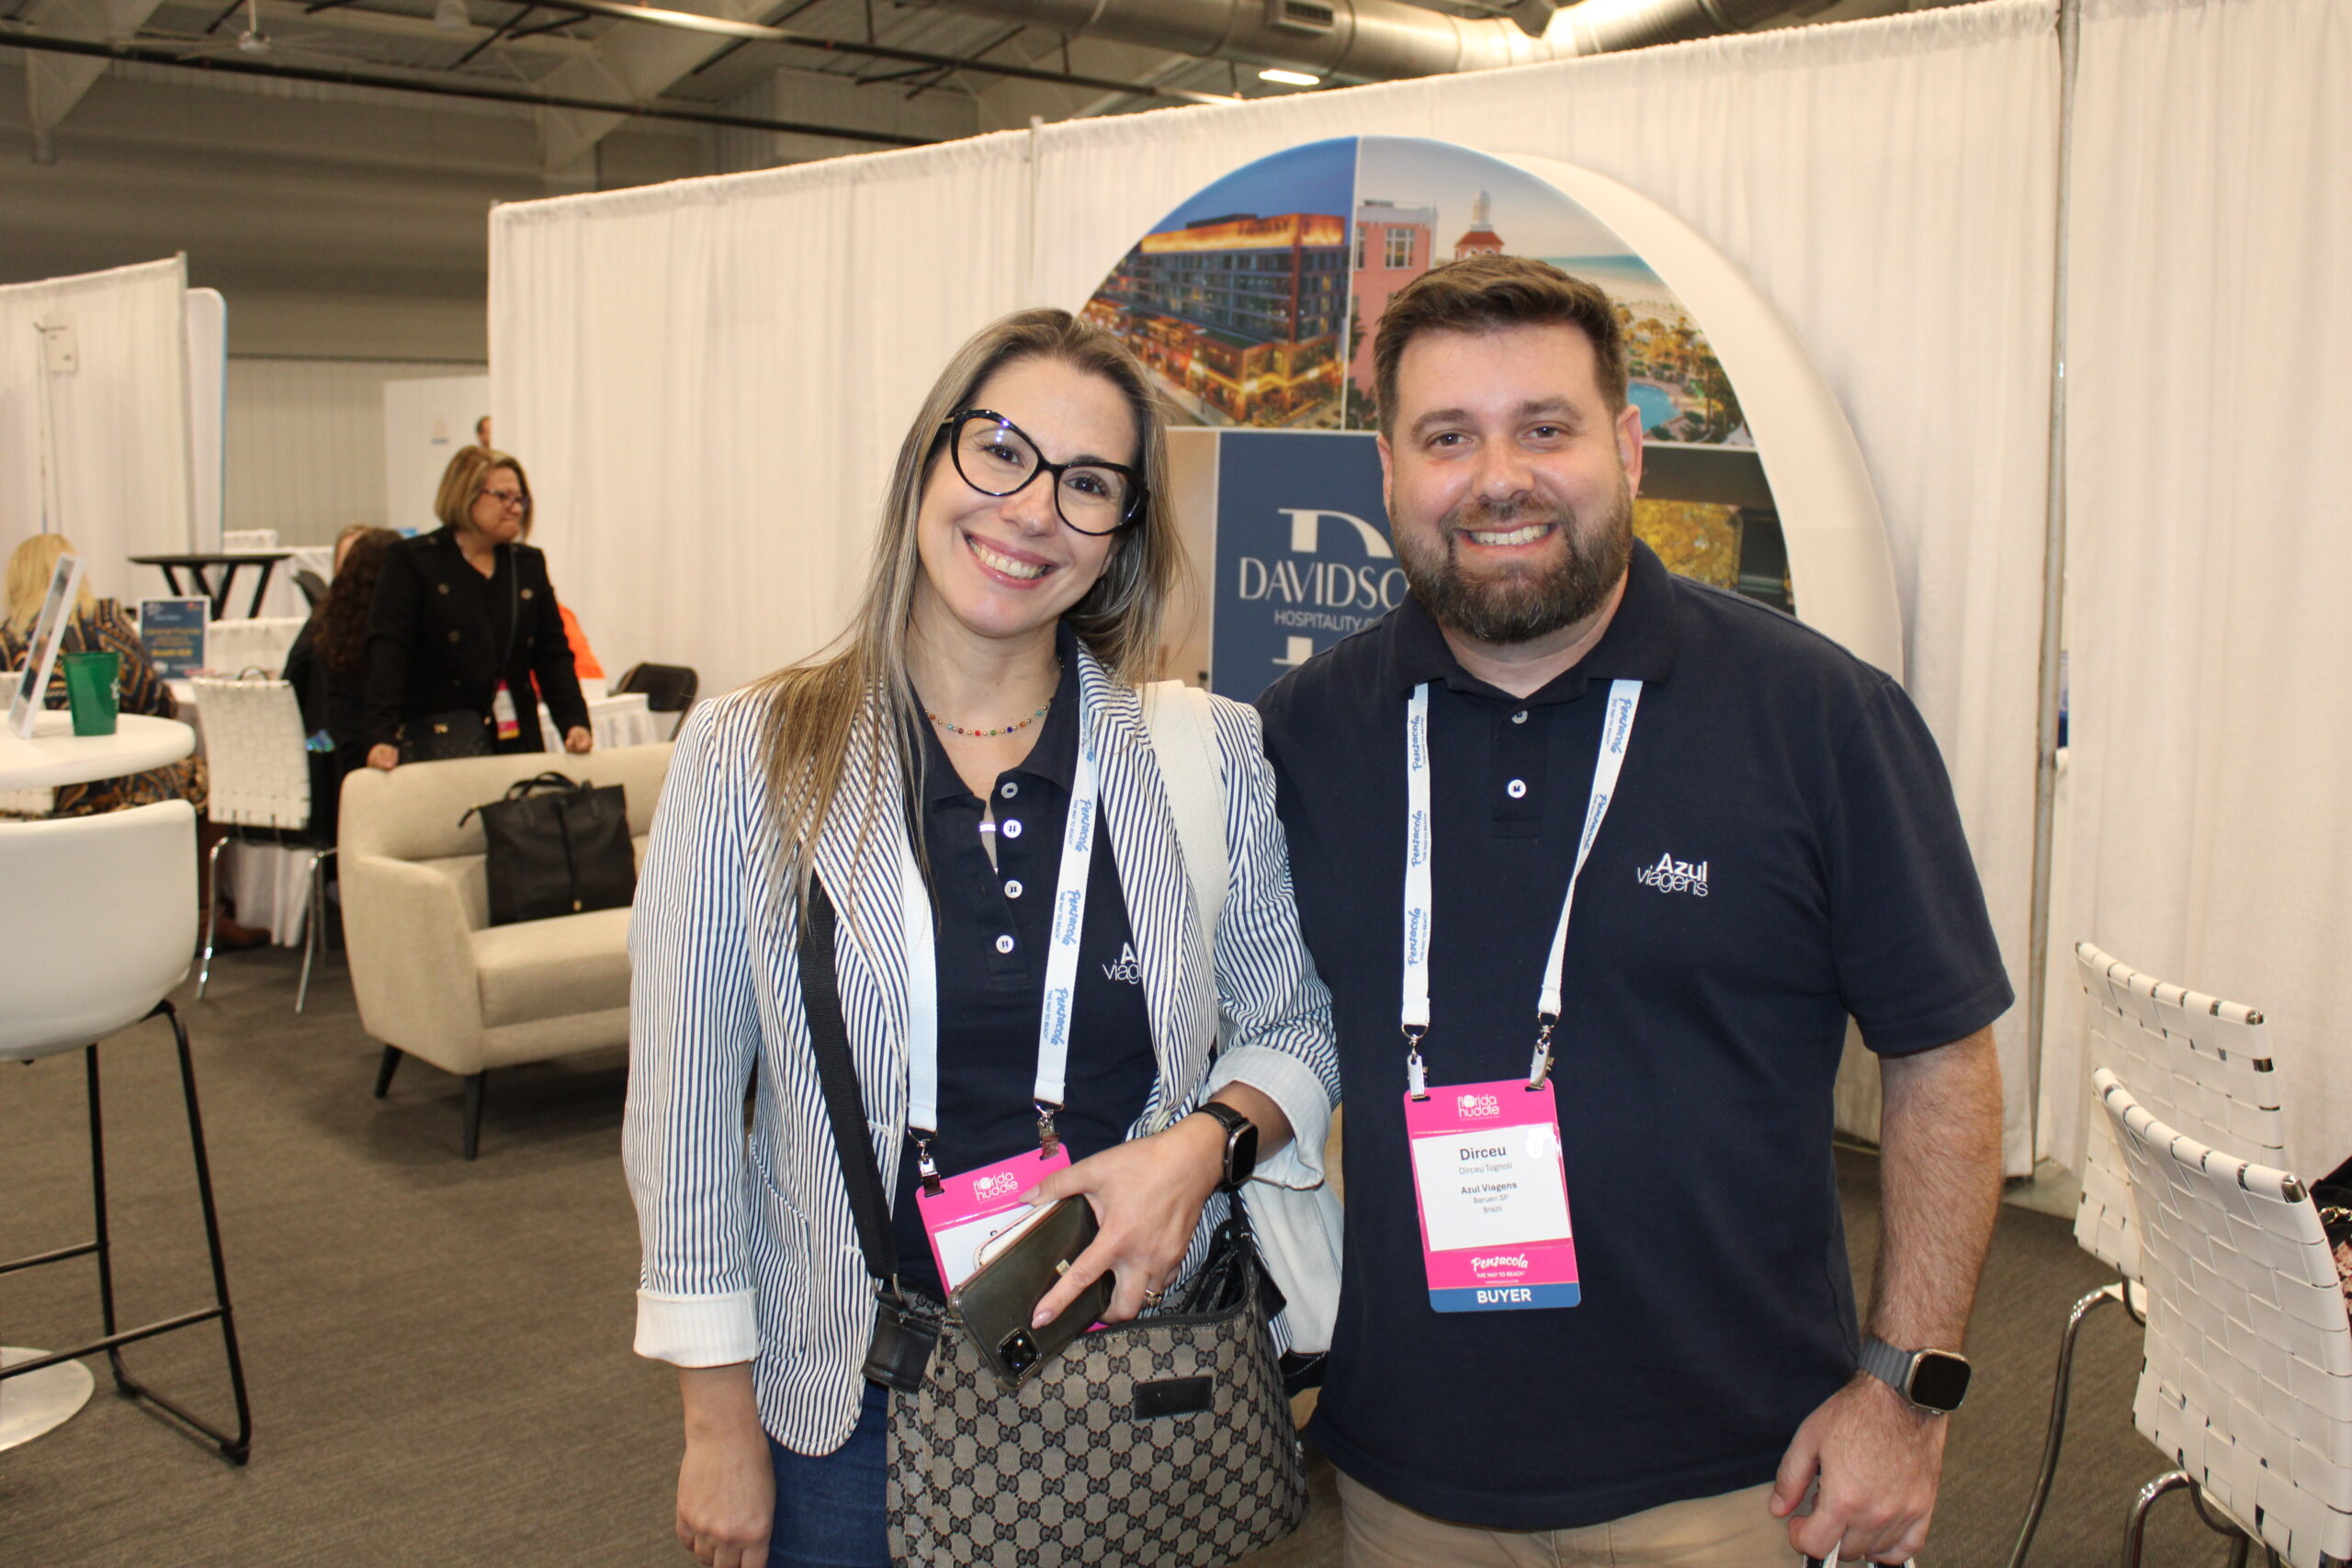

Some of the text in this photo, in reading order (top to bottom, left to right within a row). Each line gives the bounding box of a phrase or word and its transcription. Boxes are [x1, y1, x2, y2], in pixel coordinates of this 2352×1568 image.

[1239, 557, 1410, 610] DAVIDSO
[1274, 609, 1362, 631] HOSPITALITY
[1609, 697, 1633, 755] Pensacola
[1411, 715, 1423, 773] Pensacola
[1075, 798, 1092, 852] Pensacola
[1410, 809, 1422, 867] Pensacola
[1637, 864, 1709, 897] viagens
[1656, 852, 1708, 882] Azul
[1061, 889, 1080, 947] Pensacola
[1408, 907, 1421, 966] Pensacola
[1102, 958, 1142, 985] viag
[1050, 987, 1069, 1046] Pensacola
[1458, 1104, 1499, 1118] huddle
[1460, 1146, 1507, 1161] Dirceu
[1459, 1166, 1485, 1175] Dirceu
[977, 1180, 1018, 1201] huddle
[1461, 1182, 1518, 1194] Azul Viagens
[1499, 1193, 1509, 1201] SP
[1483, 1205, 1502, 1213] Brazil
[1470, 1253, 1529, 1272] Pensacola
[1476, 1288, 1532, 1304] BUYER
